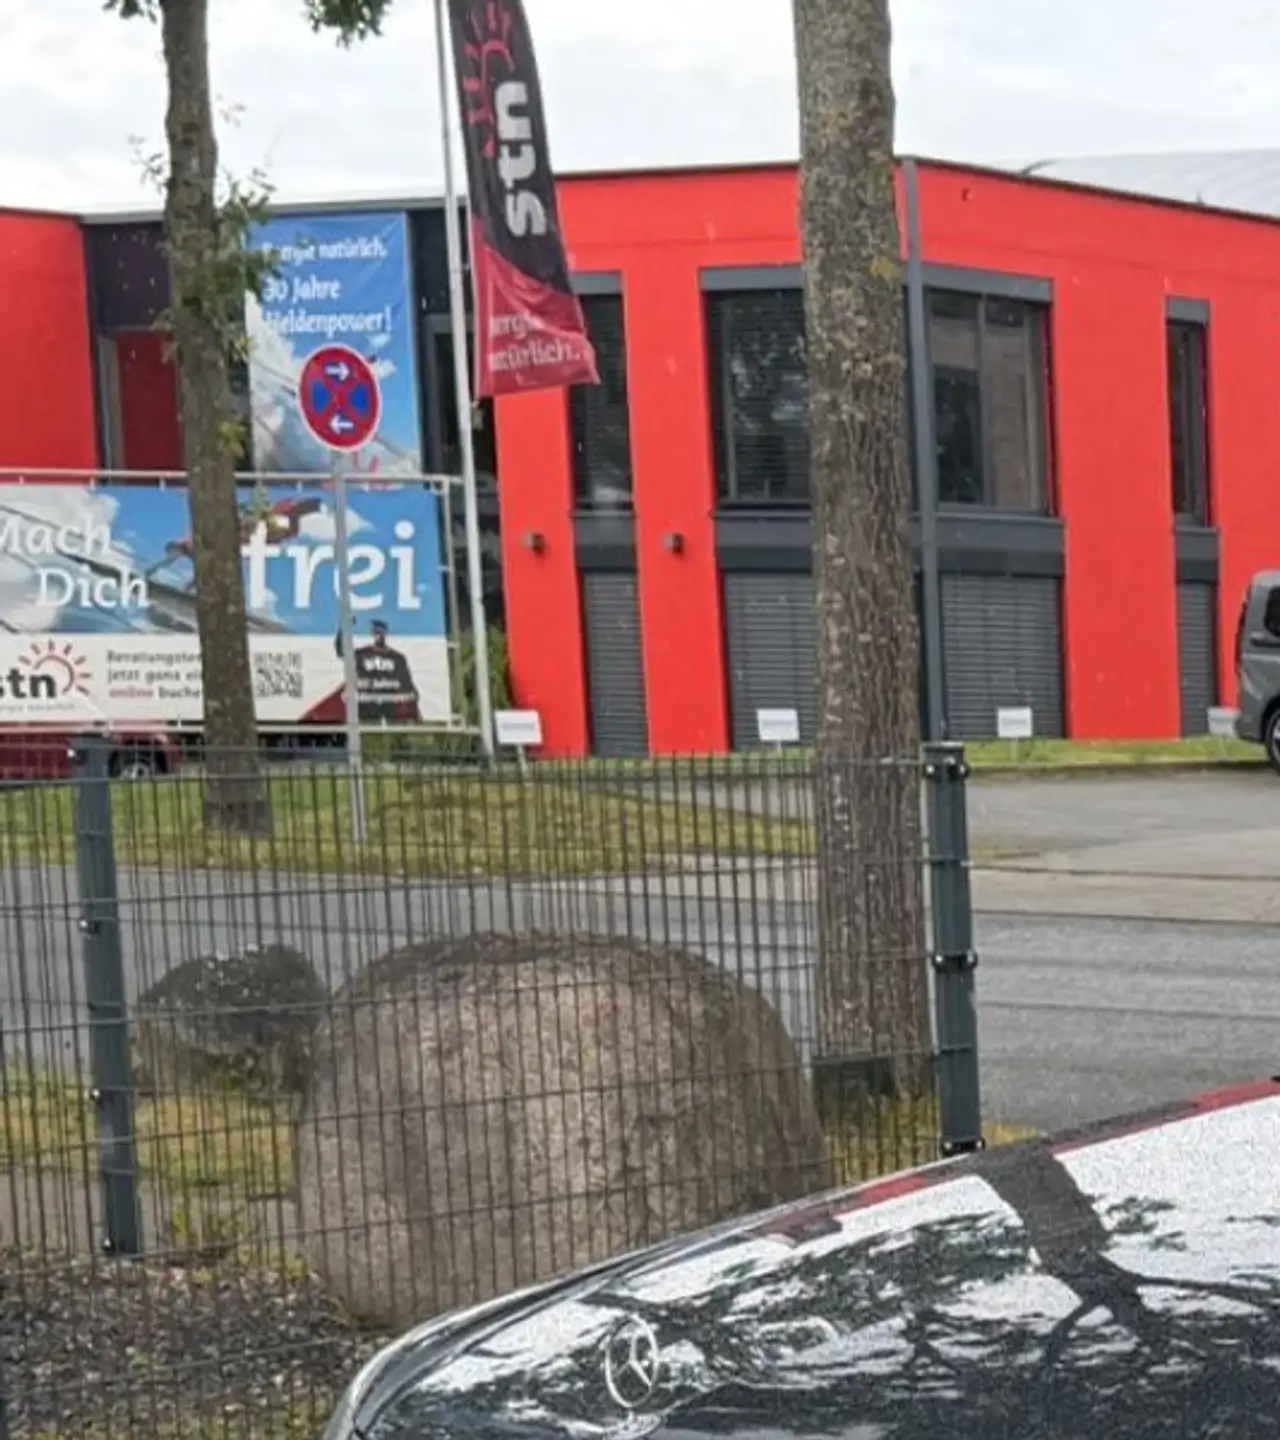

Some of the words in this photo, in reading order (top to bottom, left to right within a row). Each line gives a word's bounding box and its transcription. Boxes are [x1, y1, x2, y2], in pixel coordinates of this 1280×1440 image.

[496, 80, 547, 237] stn
[292, 273, 341, 304] Jahre
[34, 564, 149, 608] Dich
